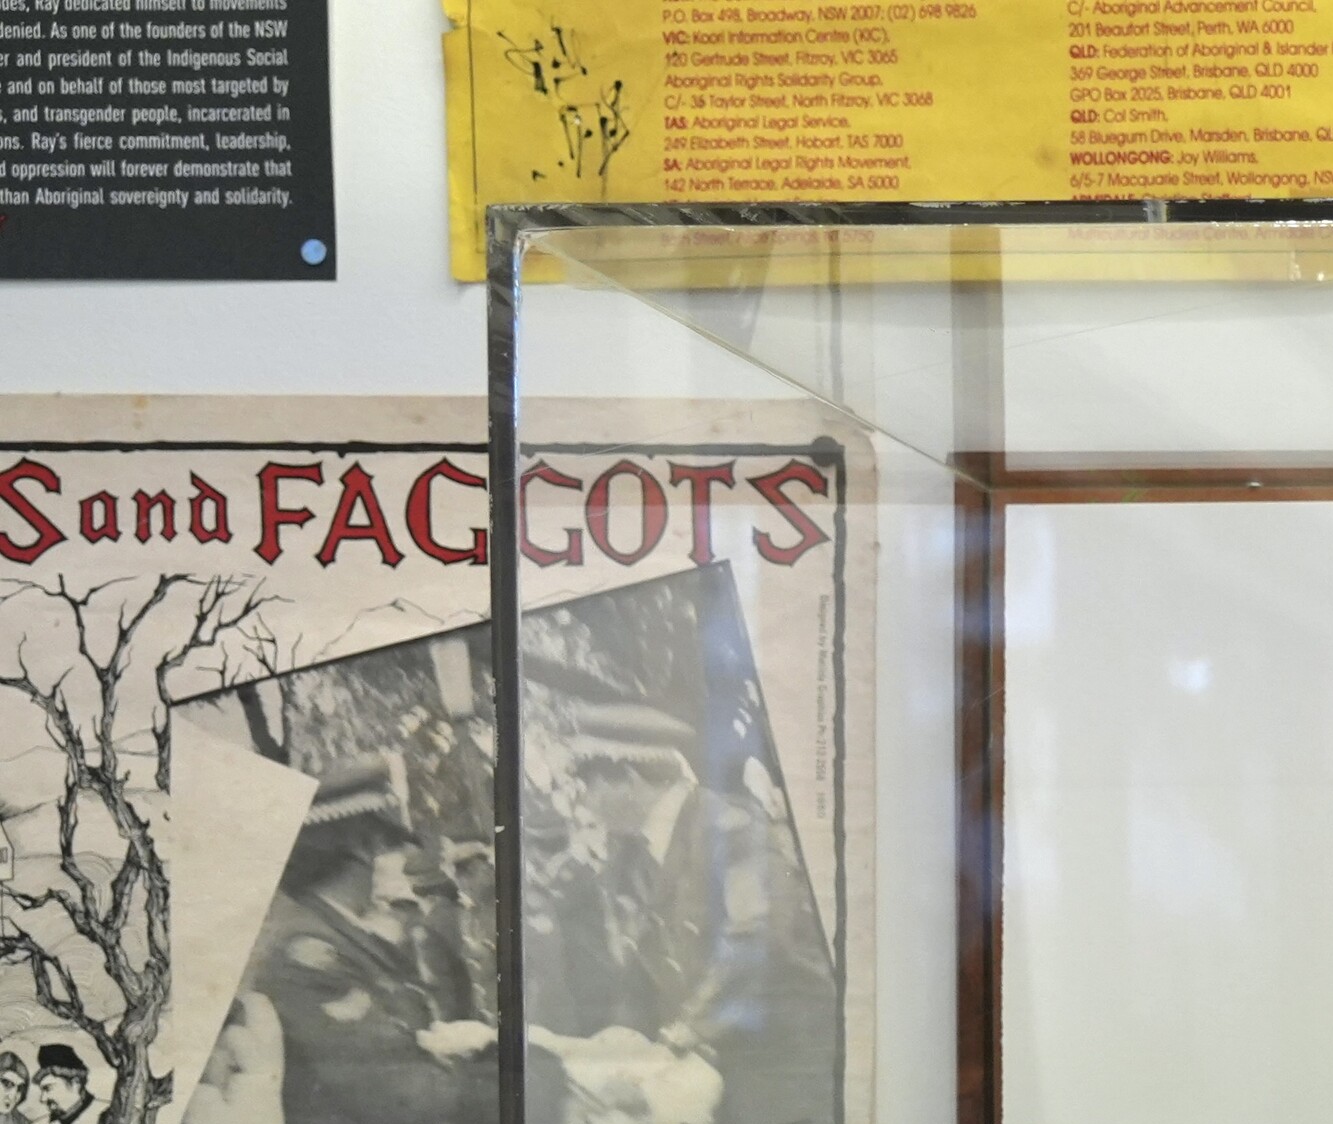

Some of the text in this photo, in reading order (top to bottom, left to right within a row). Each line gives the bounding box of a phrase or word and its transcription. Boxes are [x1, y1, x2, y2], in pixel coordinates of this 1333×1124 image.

[50, 20, 288, 39] As one of the founders of the NSW
[1103, 44, 1173, 60] Federation
[1176, 43, 1190, 58] of
[1192, 42, 1259, 62] Aboriginal
[1262, 42, 1274, 57] &
[1276, 41, 1329, 57] Islander
[692, 115, 760, 133] Aboriginal
[762, 115, 799, 133] Legal
[1069, 150, 1174, 166] WOLLONGONG:
[1176, 150, 1200, 168] Joy
[35, 188, 104, 209] Aboriginal
[110, 188, 190, 209] sovereignty
[194, 188, 220, 206] and
[224, 187, 294, 209] solidarity.
[77, 470, 233, 545] and
[253, 457, 834, 568] FAGGOTS
